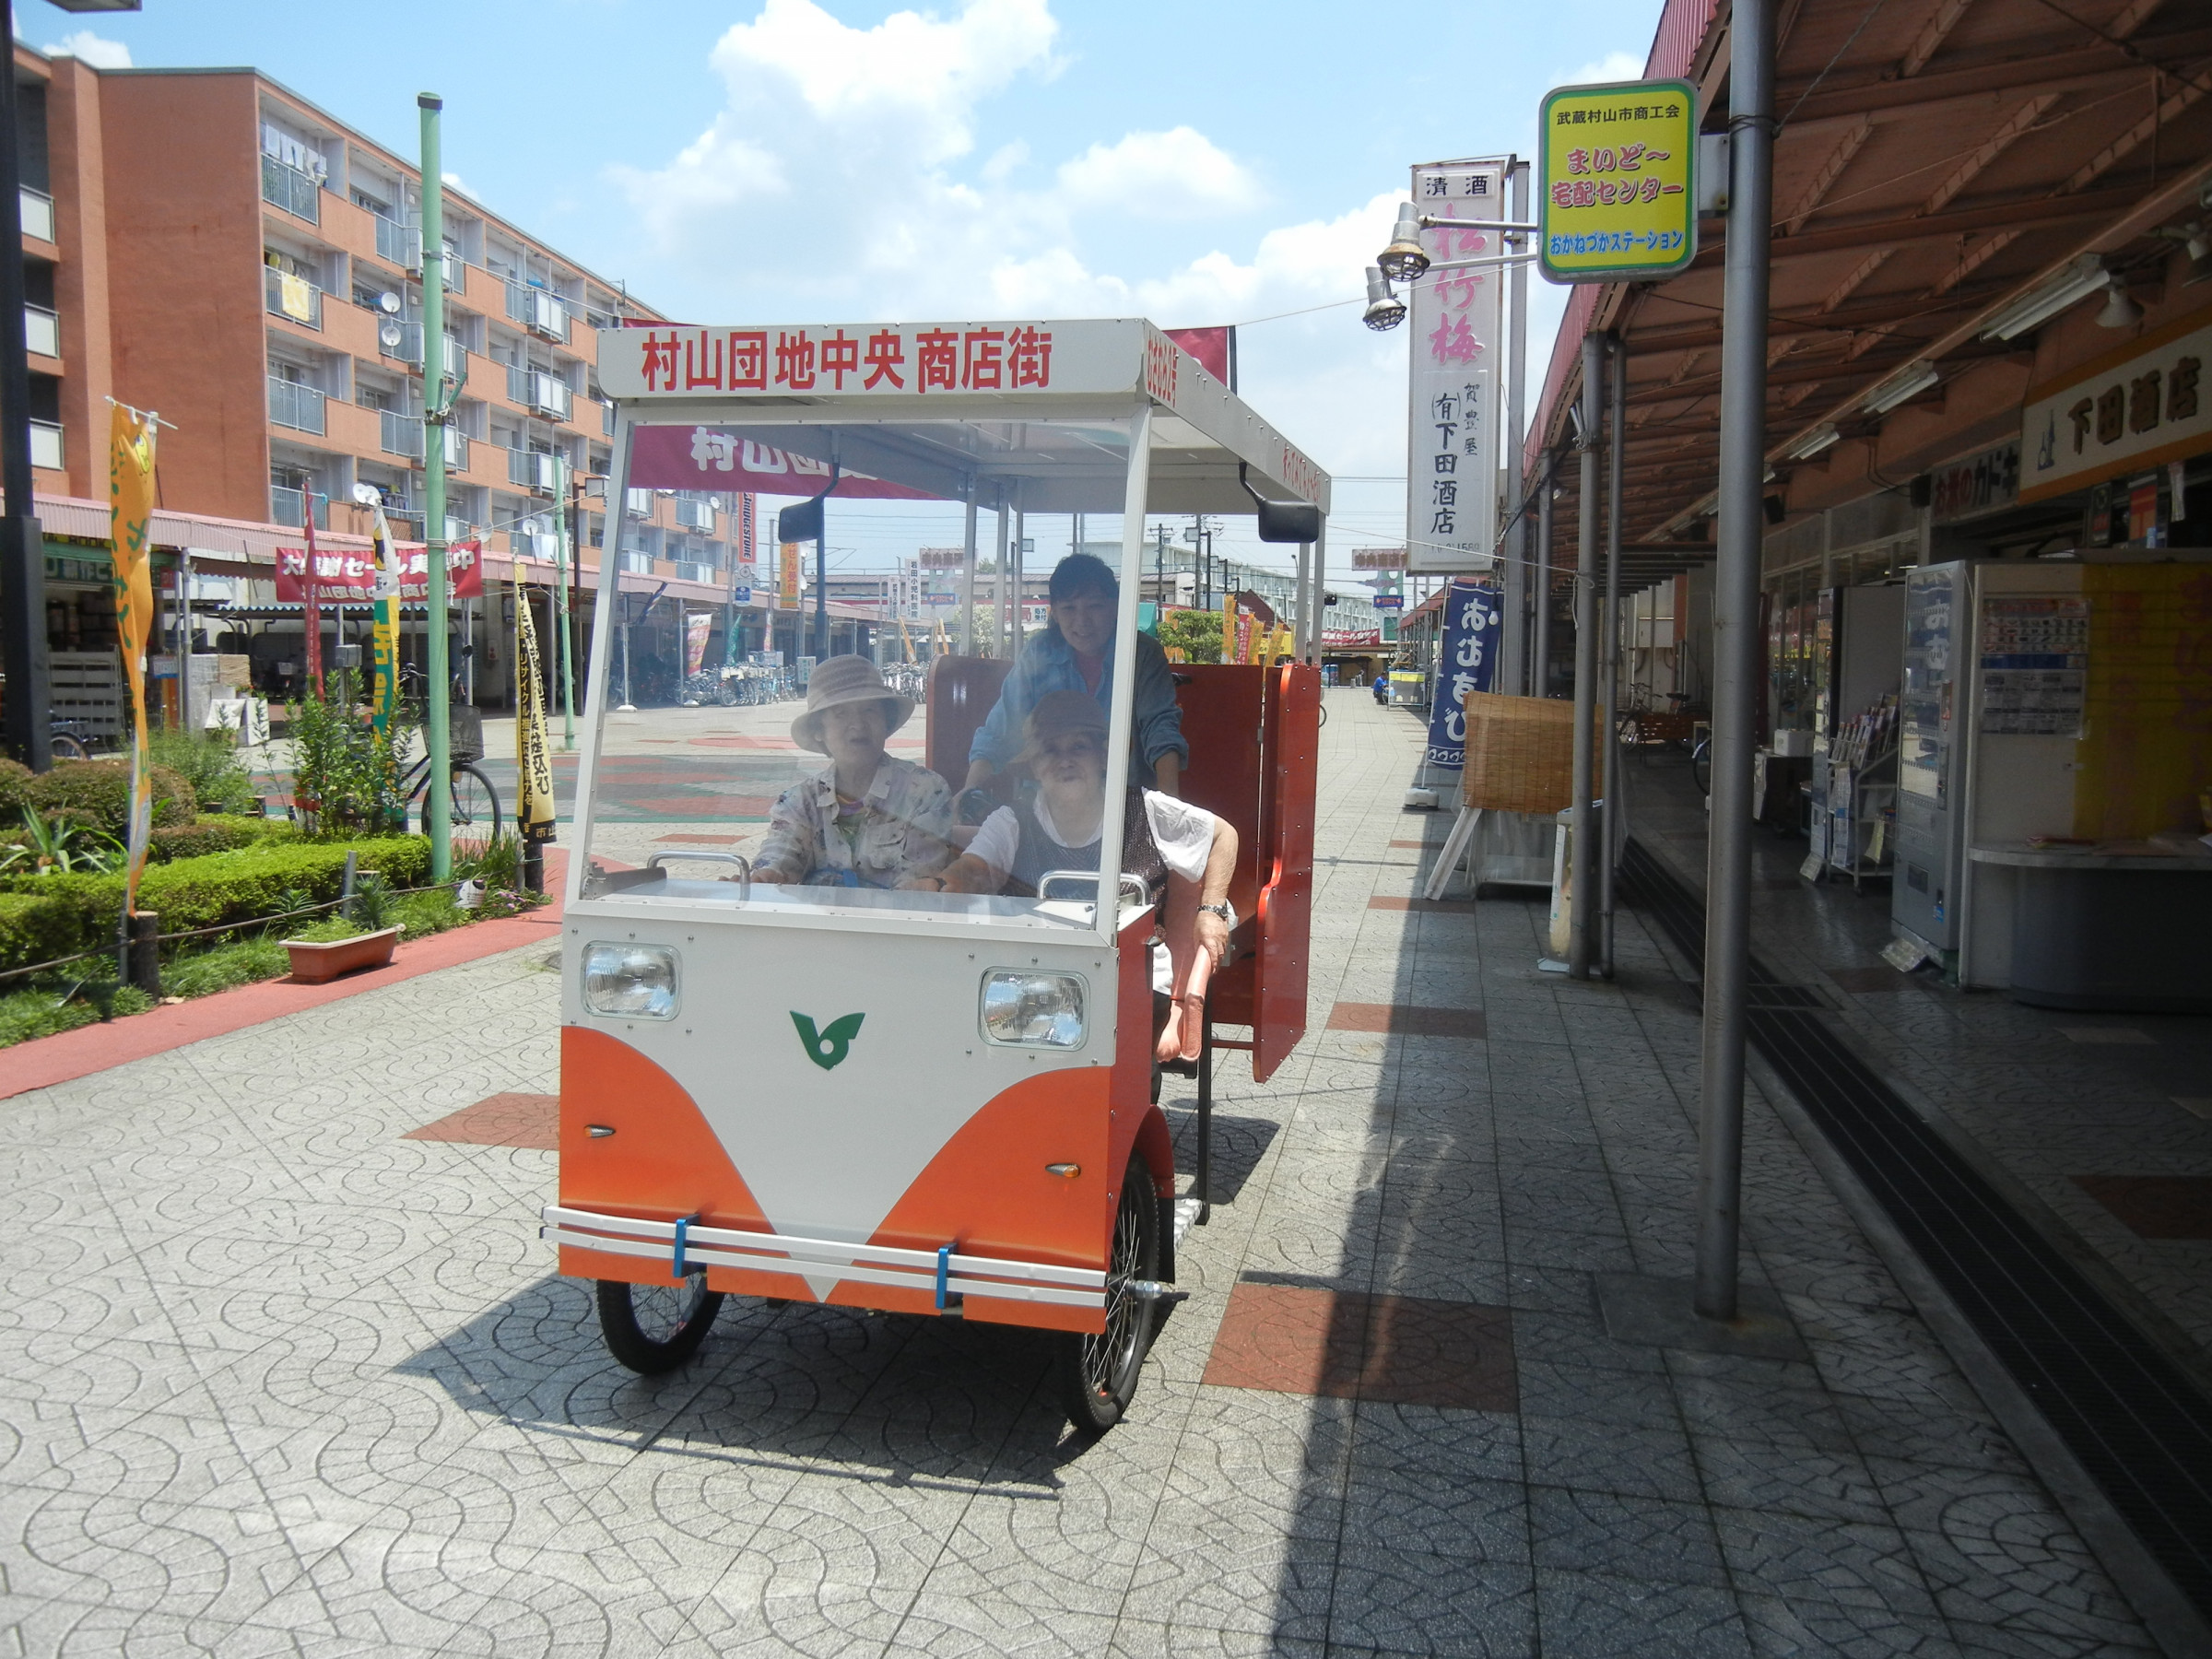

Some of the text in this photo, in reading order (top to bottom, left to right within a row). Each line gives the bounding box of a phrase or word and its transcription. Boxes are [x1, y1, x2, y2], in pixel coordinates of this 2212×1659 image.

[1556, 103, 1680, 125] 武蔵村山市商工会
[1426, 175, 1488, 196] 清酒
[1550, 180, 1684, 208] 宅配センター
[1549, 229, 1684, 256] おかねづかステーション
[1429, 203, 1487, 365] 松竹梅
[641, 324, 1053, 394] 村山団地中央商店街
[2067, 356, 2202, 455] 下田酒店
[691, 426, 877, 480] 村山団
